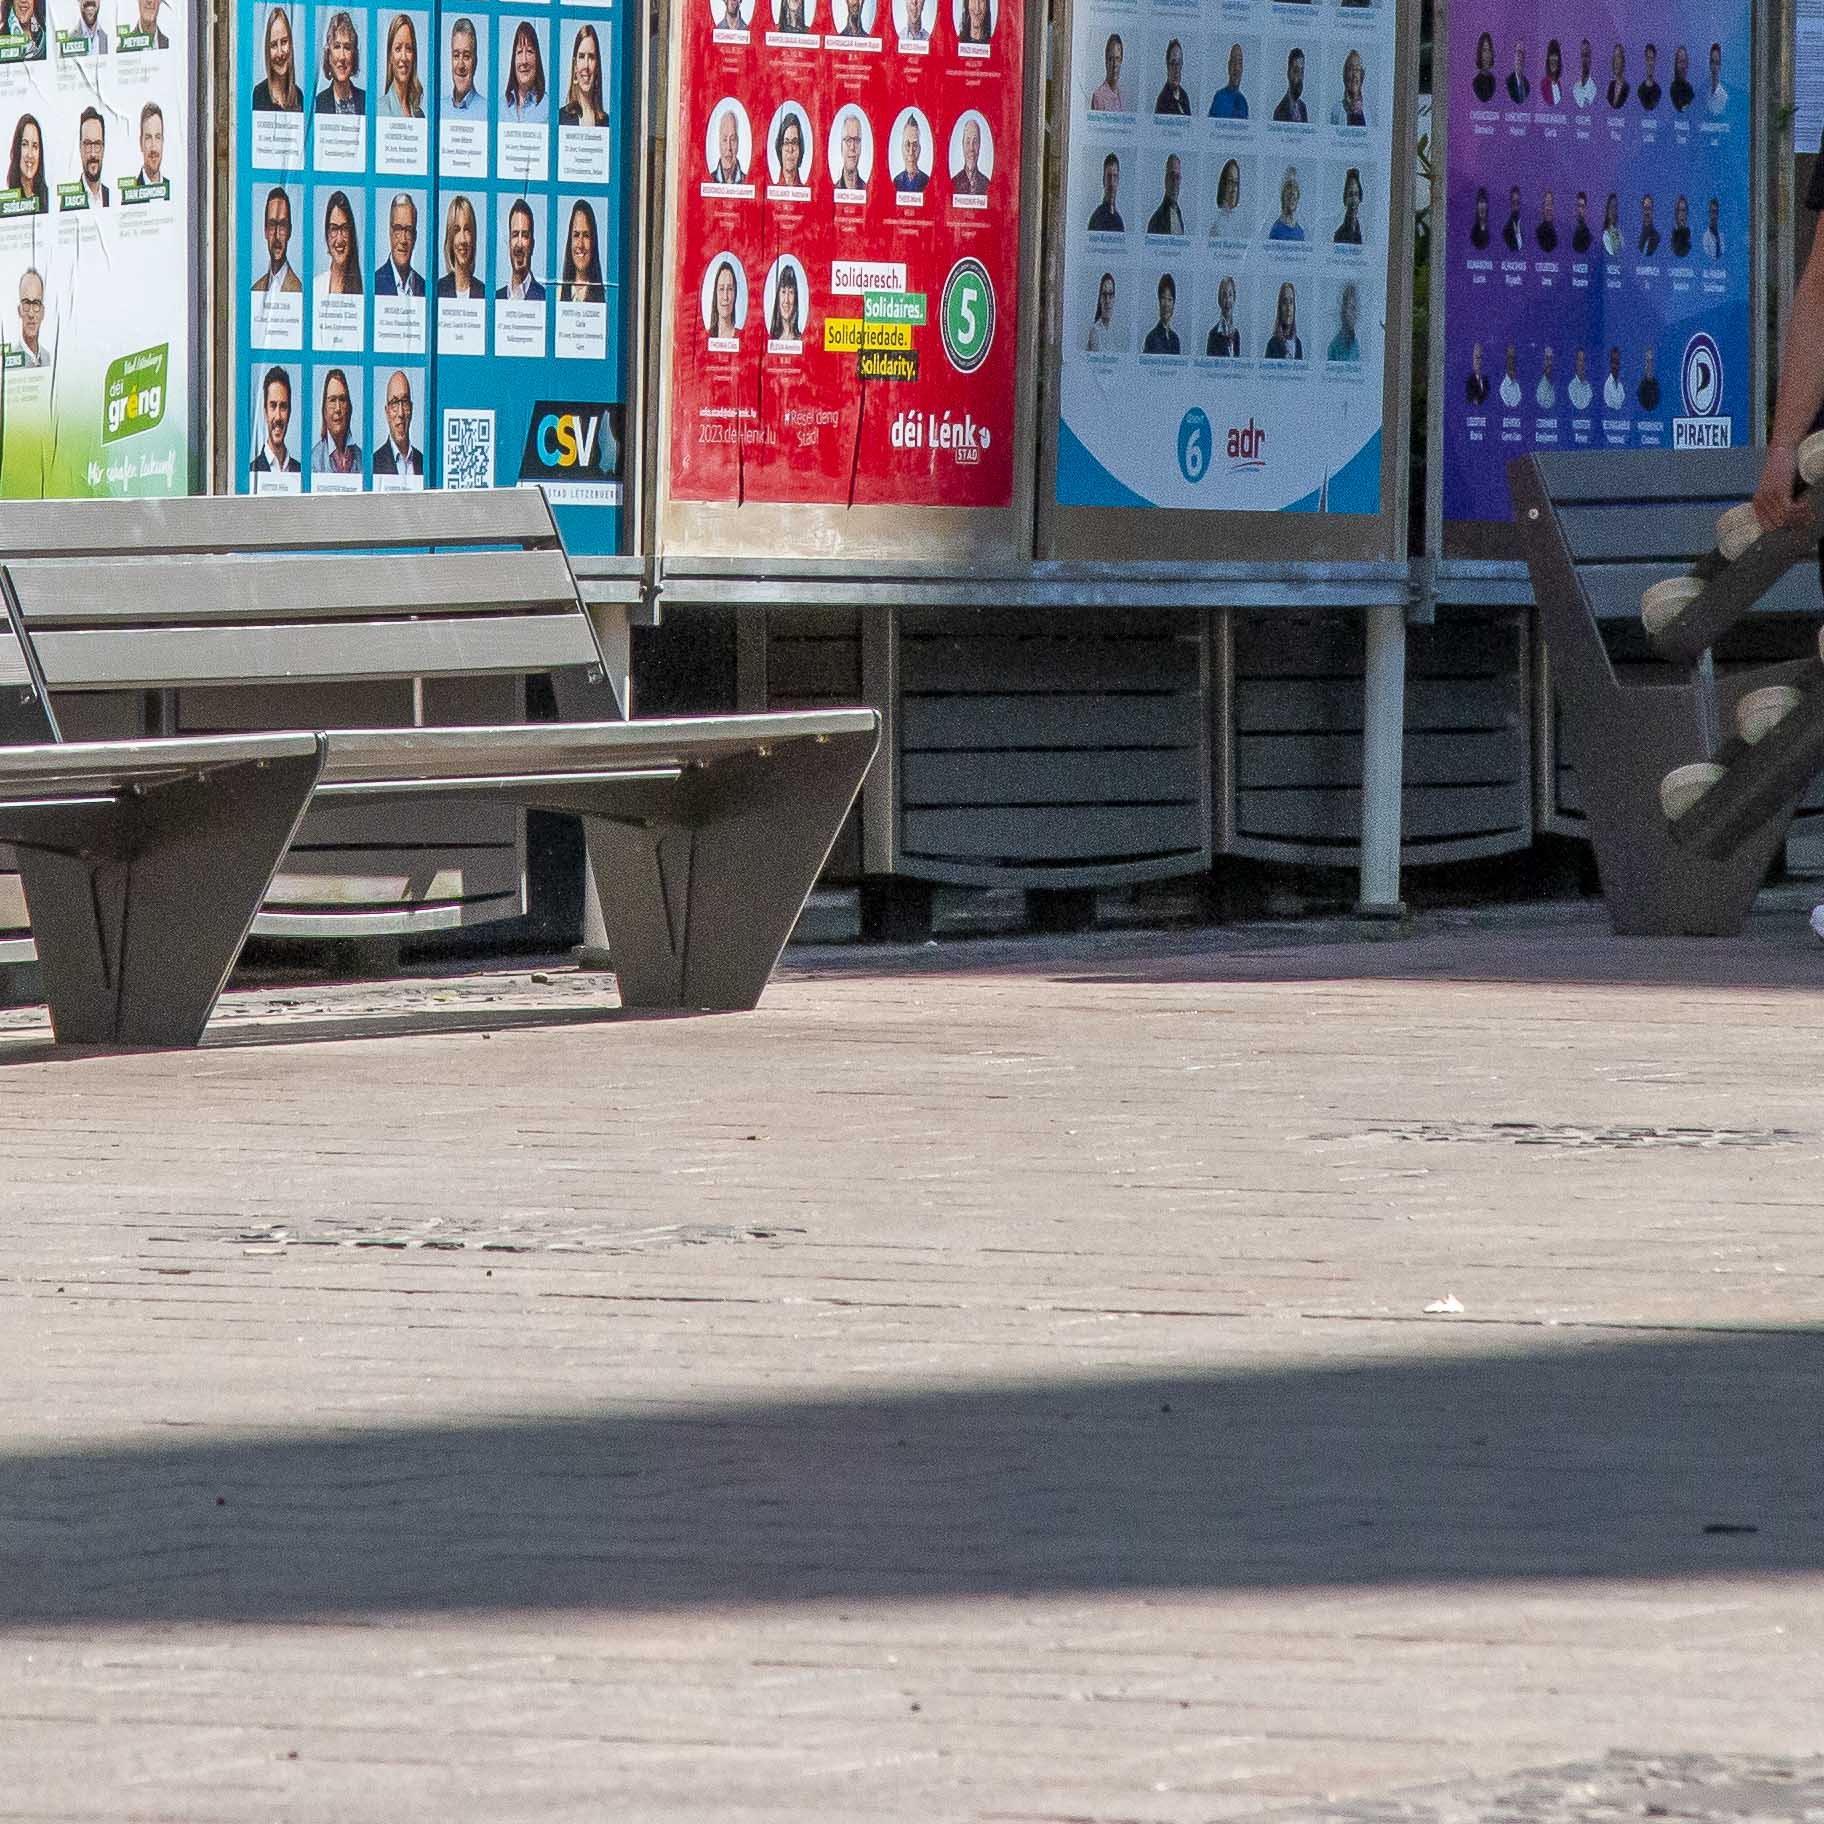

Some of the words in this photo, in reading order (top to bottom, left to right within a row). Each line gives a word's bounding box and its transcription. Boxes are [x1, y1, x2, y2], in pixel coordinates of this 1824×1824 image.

[834, 267, 903, 290] Solidaresch.
[865, 297, 924, 320] Solidaires.
[957, 286, 978, 346] 5
[828, 324, 909, 347] Solidariedade.
[860, 351, 917, 379] Solidarity.
[109, 379, 124, 397] déi
[108, 383, 162, 433] gréng
[537, 414, 598, 467] CSV
[698, 423, 777, 446] 2023.de-lenk.lu
[891, 411, 923, 448] déi
[1226, 417, 1266, 459] adr
[1676, 422, 1729, 448] PIRATEN
[1185, 426, 1203, 476] 6
